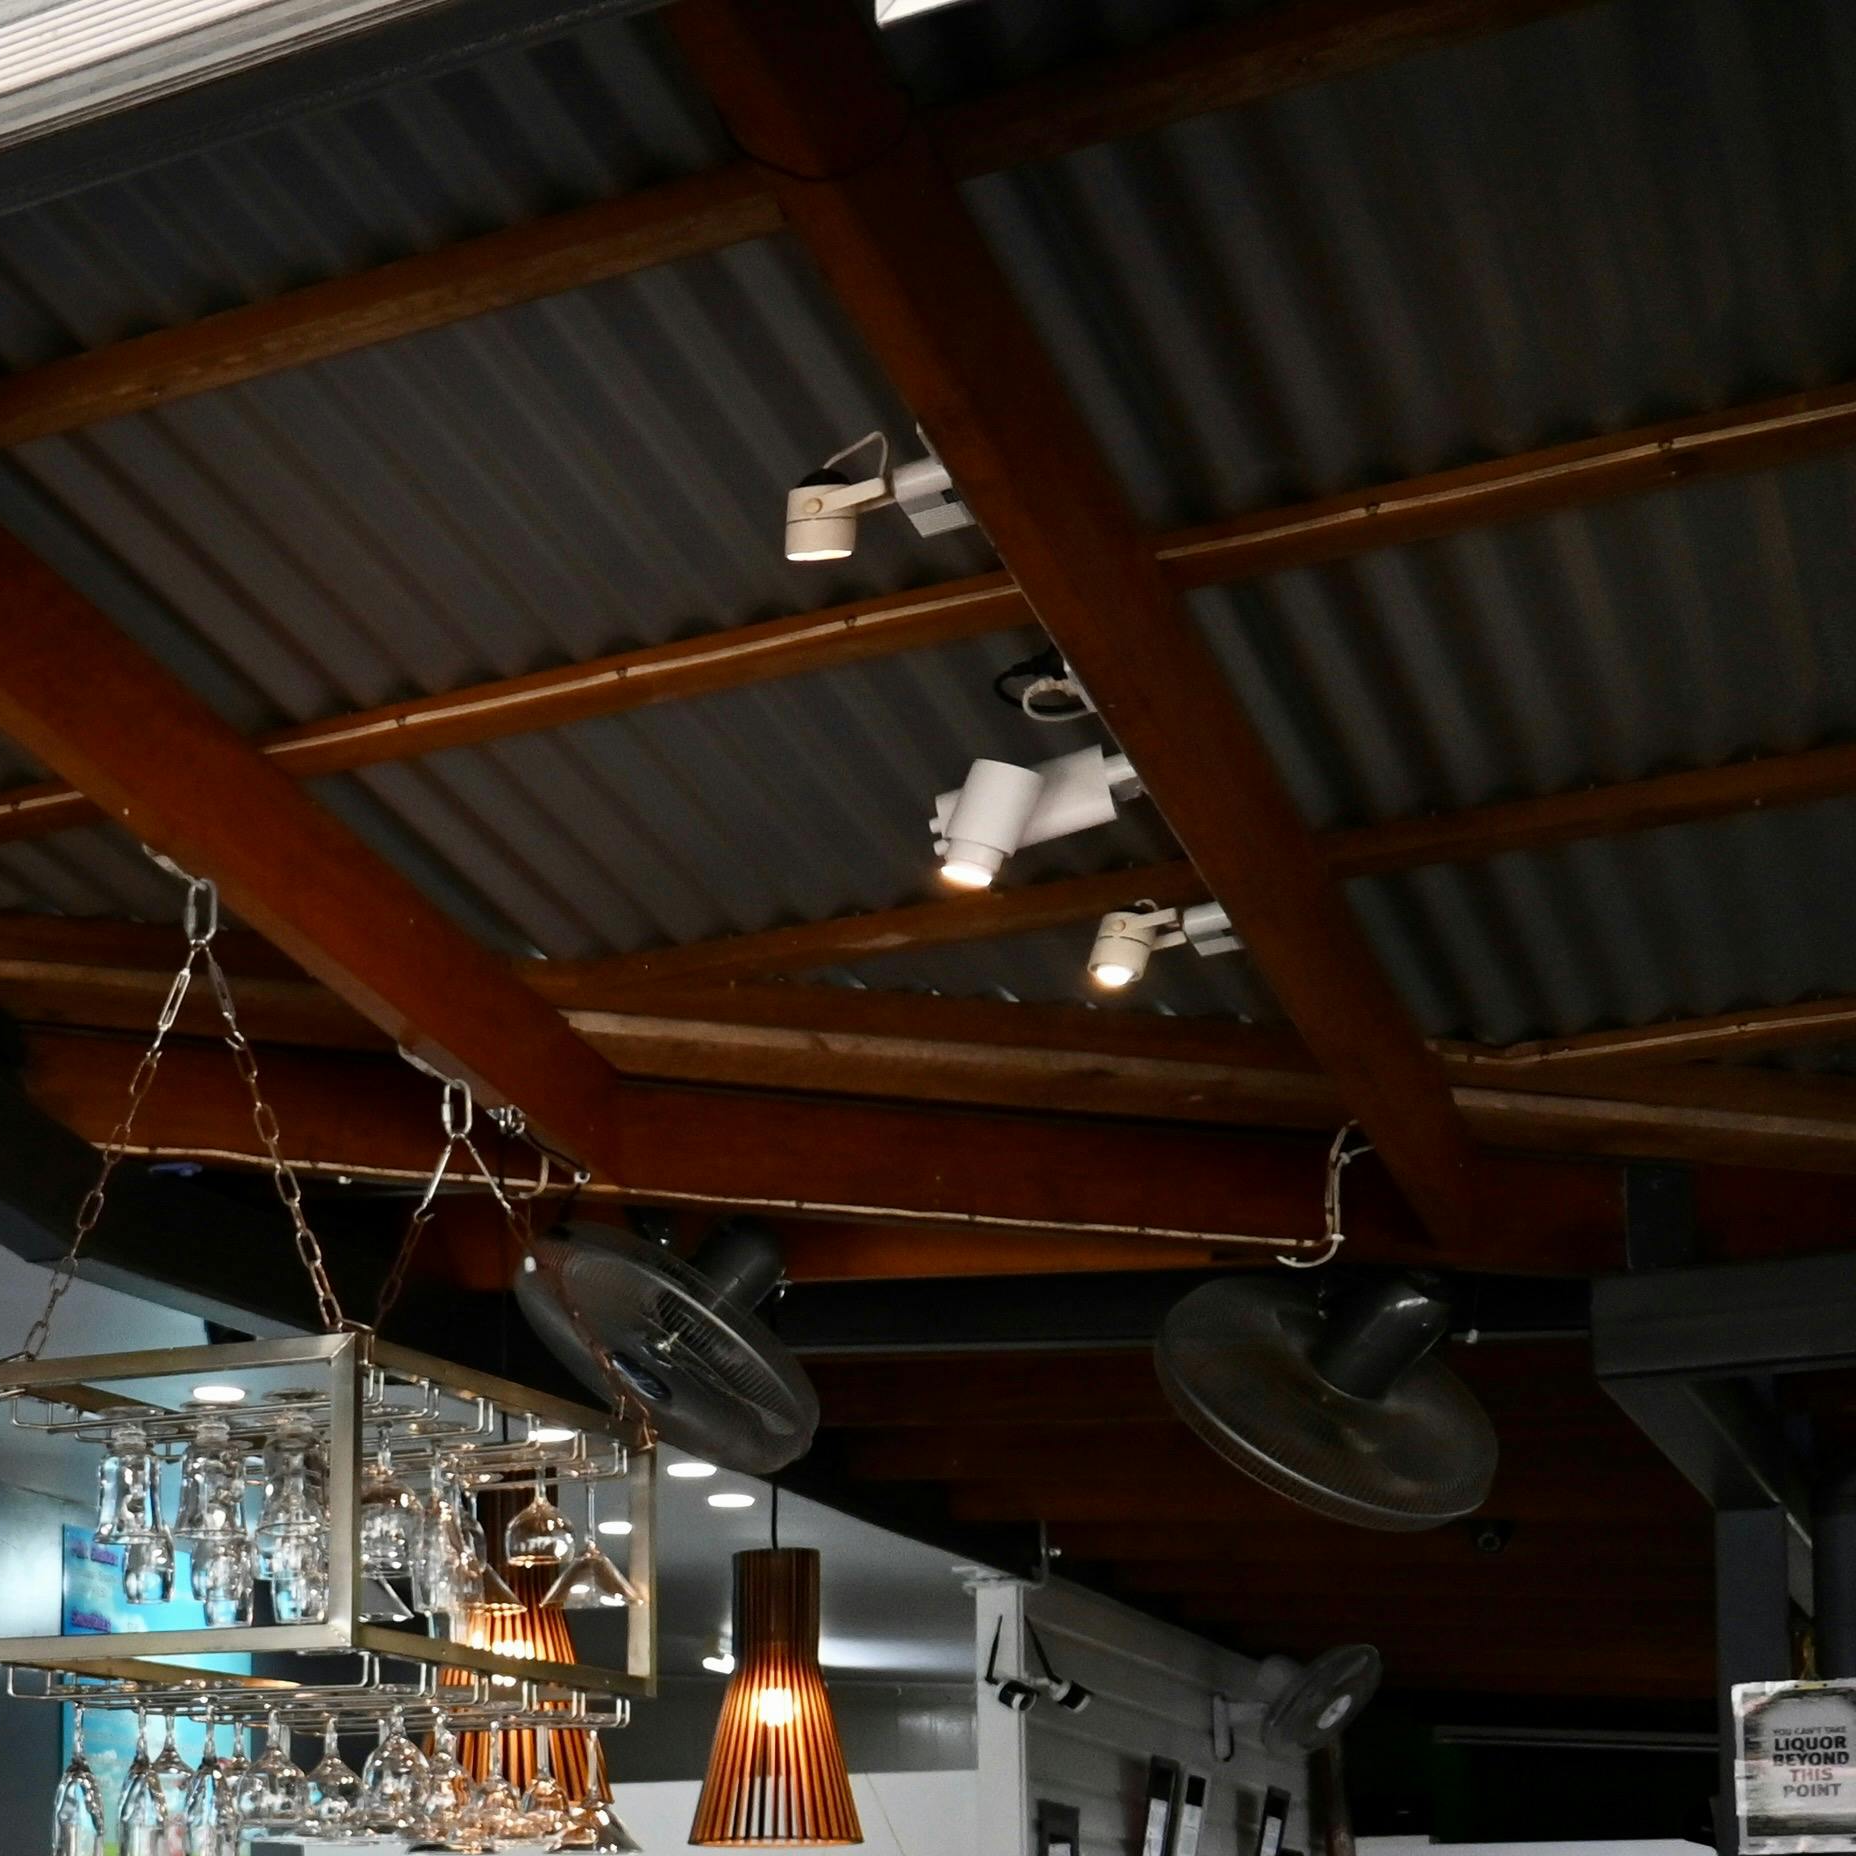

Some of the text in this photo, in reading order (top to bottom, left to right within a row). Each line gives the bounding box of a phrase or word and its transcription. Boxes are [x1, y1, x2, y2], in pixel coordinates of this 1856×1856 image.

[1774, 1735, 1847, 1752] LIQUOR
[1772, 1752, 1850, 1767] BEYOND
[1790, 1768, 1833, 1782] THIS
[1783, 1784, 1841, 1798] POINT
